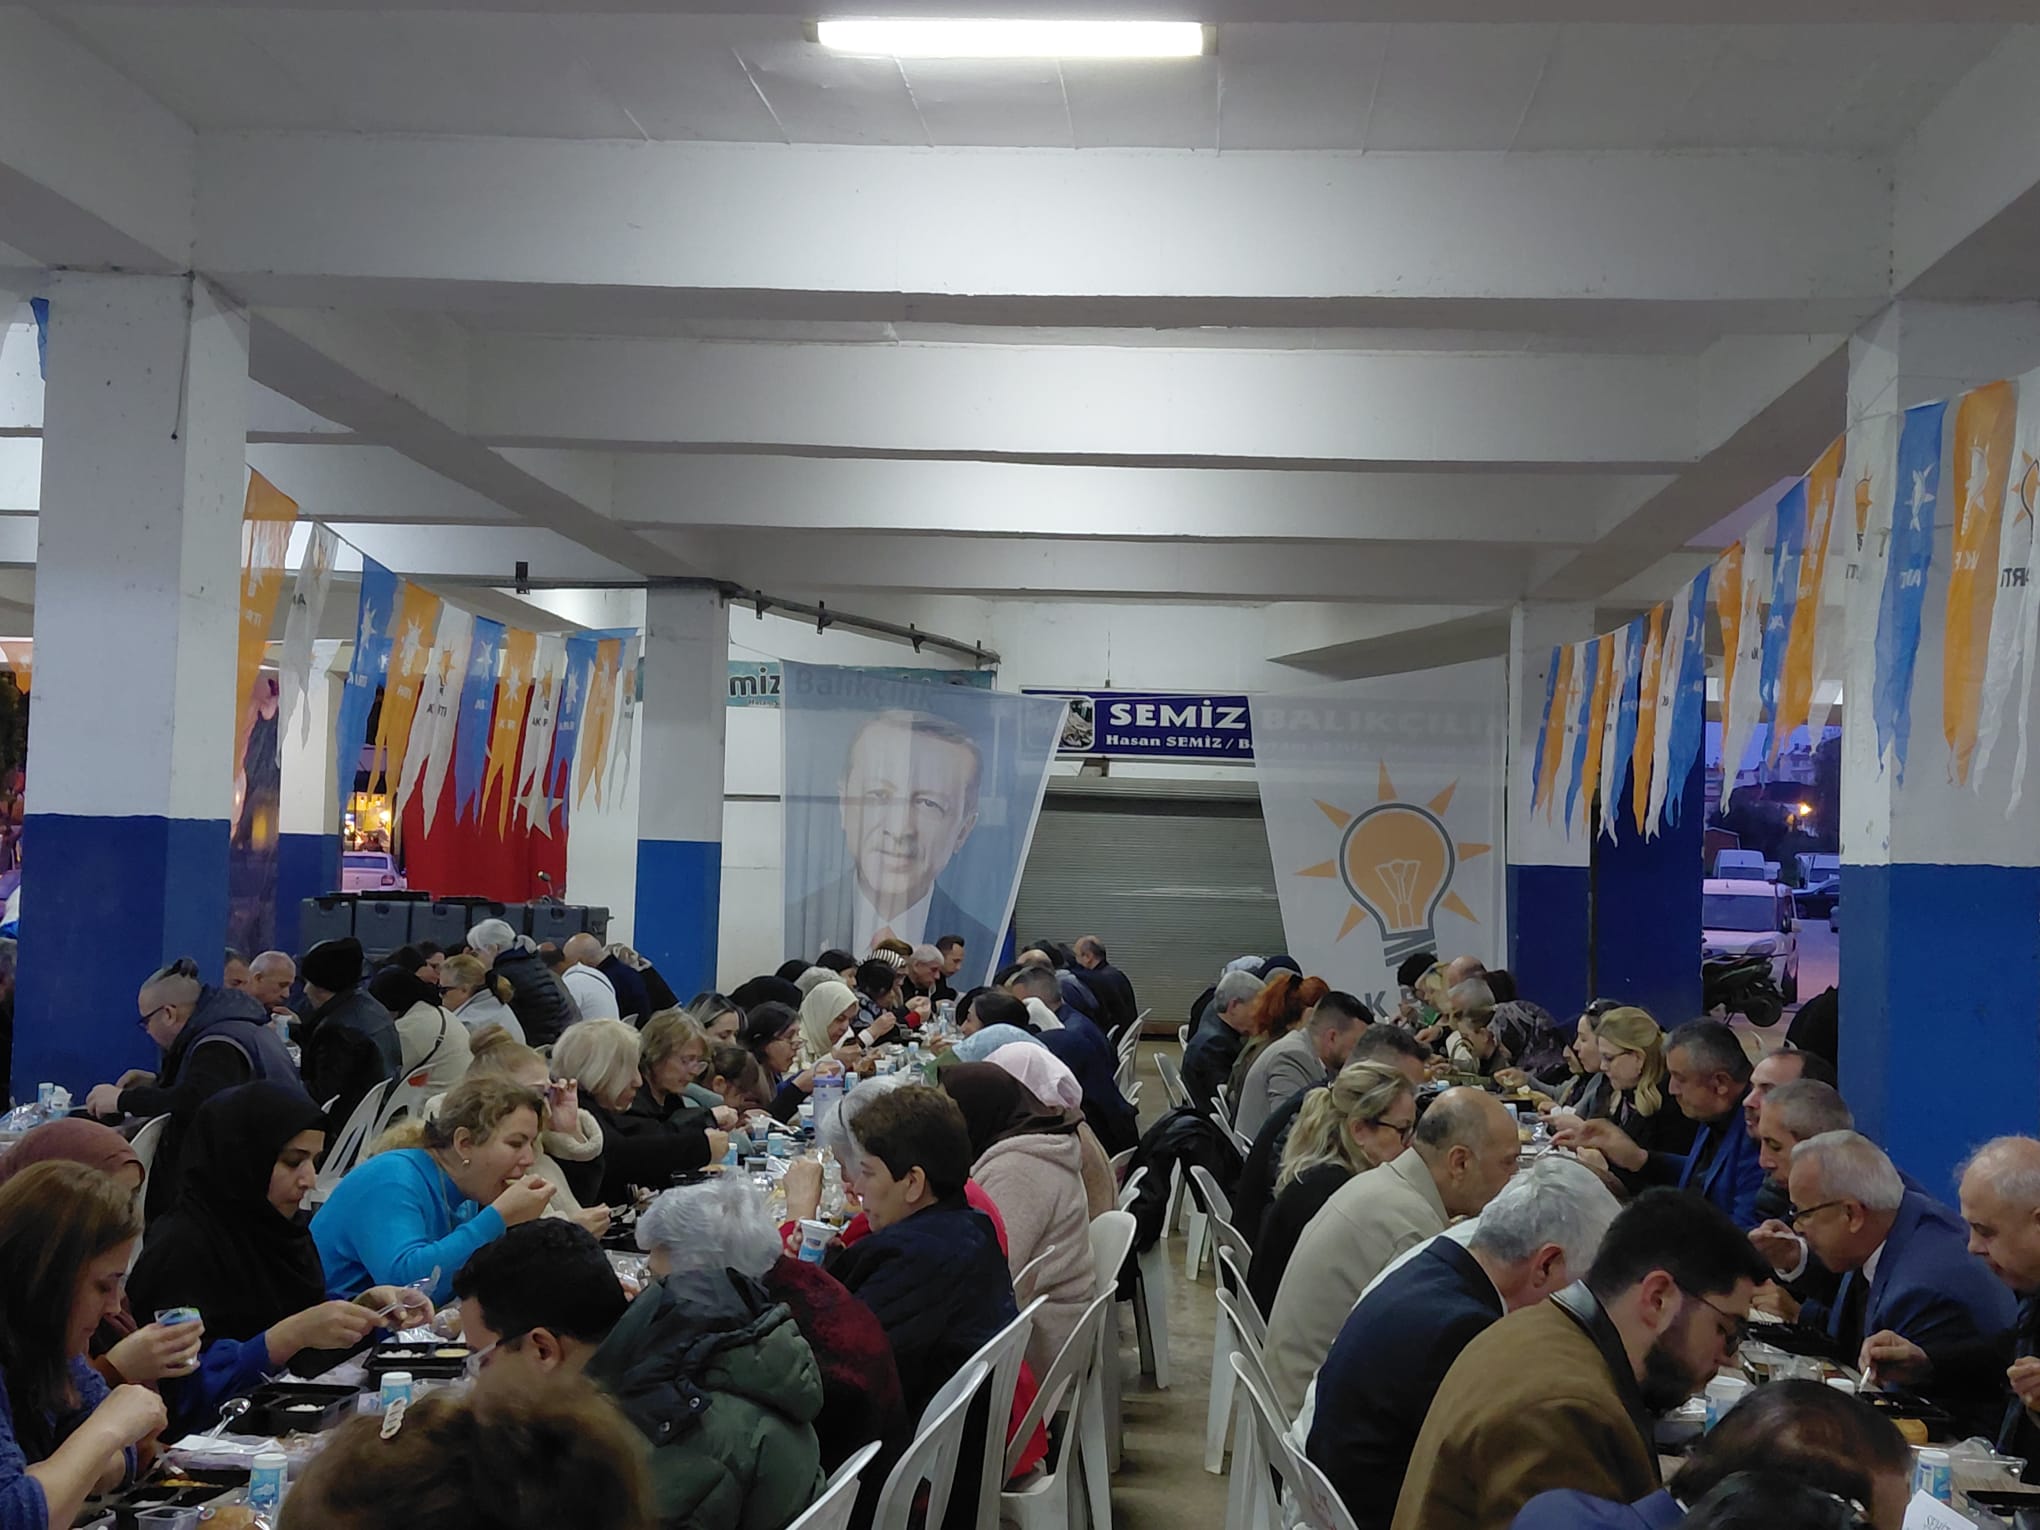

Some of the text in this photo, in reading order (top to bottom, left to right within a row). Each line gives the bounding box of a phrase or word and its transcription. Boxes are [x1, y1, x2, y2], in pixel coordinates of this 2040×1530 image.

[729, 667, 780, 697] miz
[1109, 699, 1247, 729] SEMİZ
[1106, 734, 1161, 747] Hasan
[1166, 734, 1222, 749] SEMİZ
